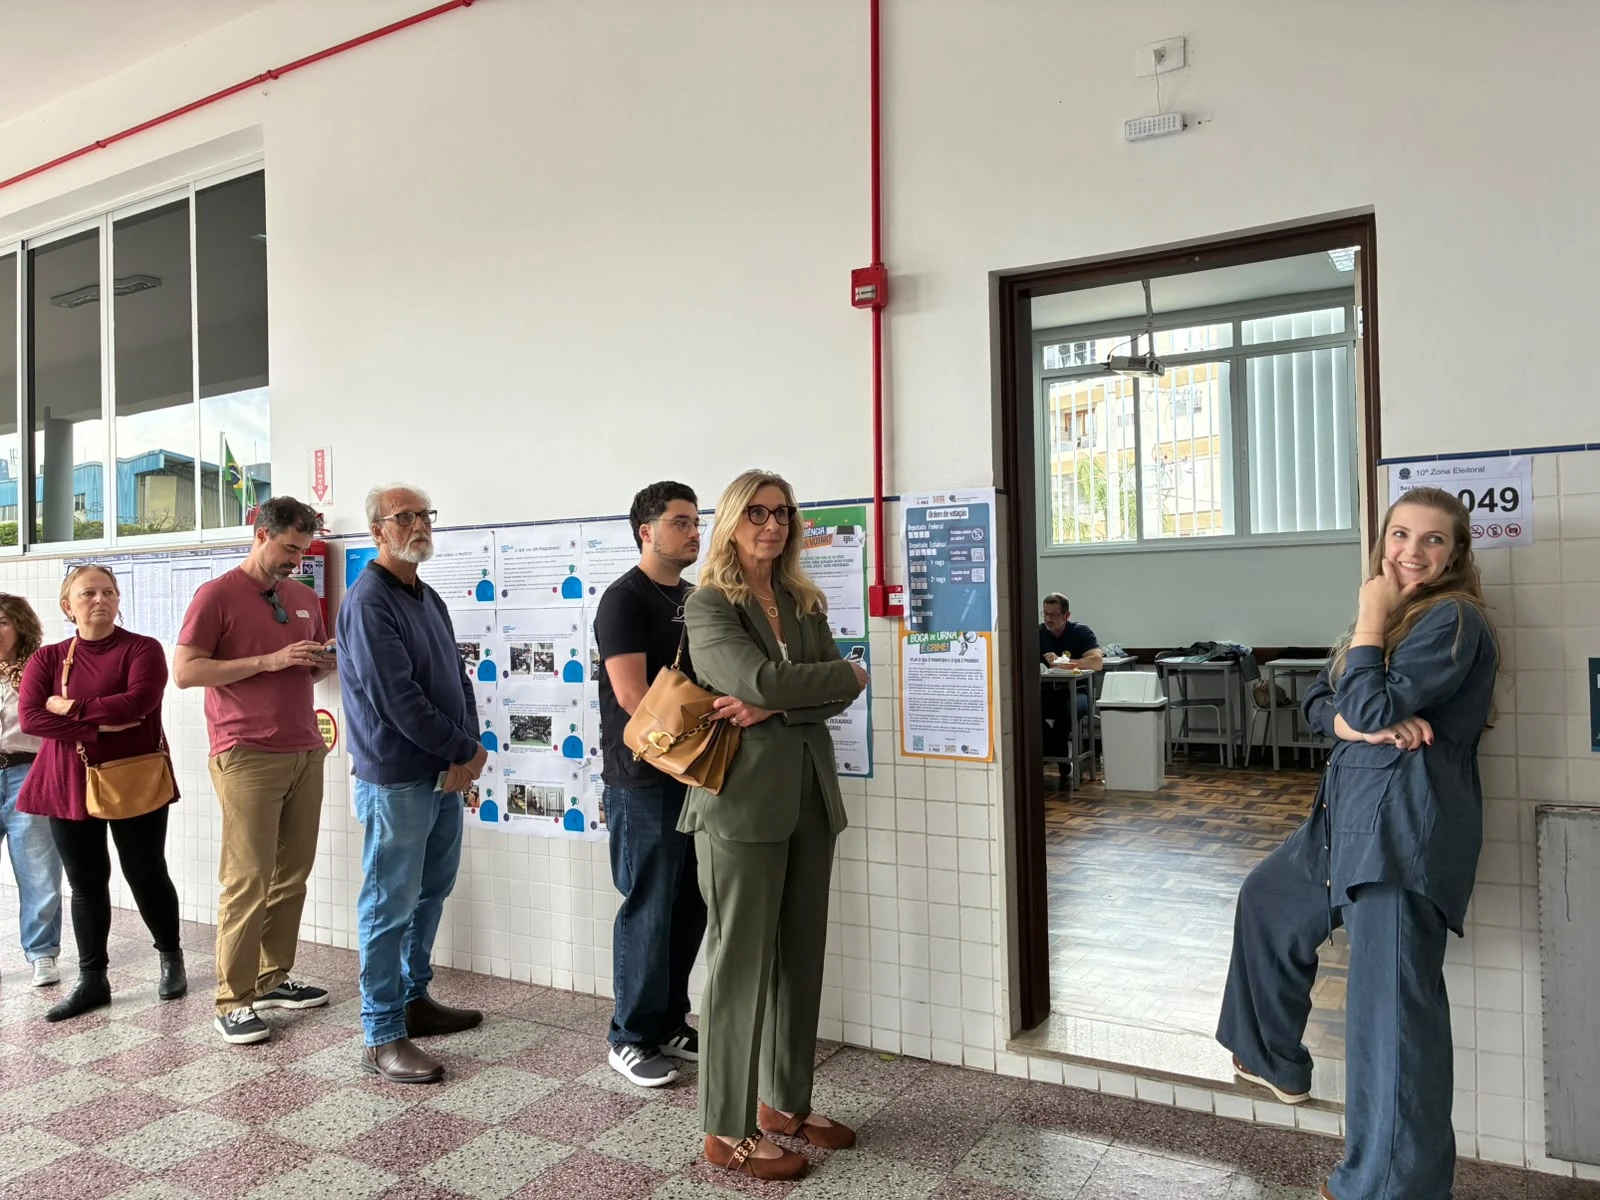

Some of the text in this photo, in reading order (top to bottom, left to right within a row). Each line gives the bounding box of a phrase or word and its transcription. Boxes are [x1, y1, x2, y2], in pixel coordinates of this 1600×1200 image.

[316, 451, 324, 495] EXTINTOR
[1430, 468, 1451, 476] Zona
[1453, 466, 1486, 475] Eleitoral
[910, 633, 929, 643] BOCA
[936, 631, 958, 641] URNA
